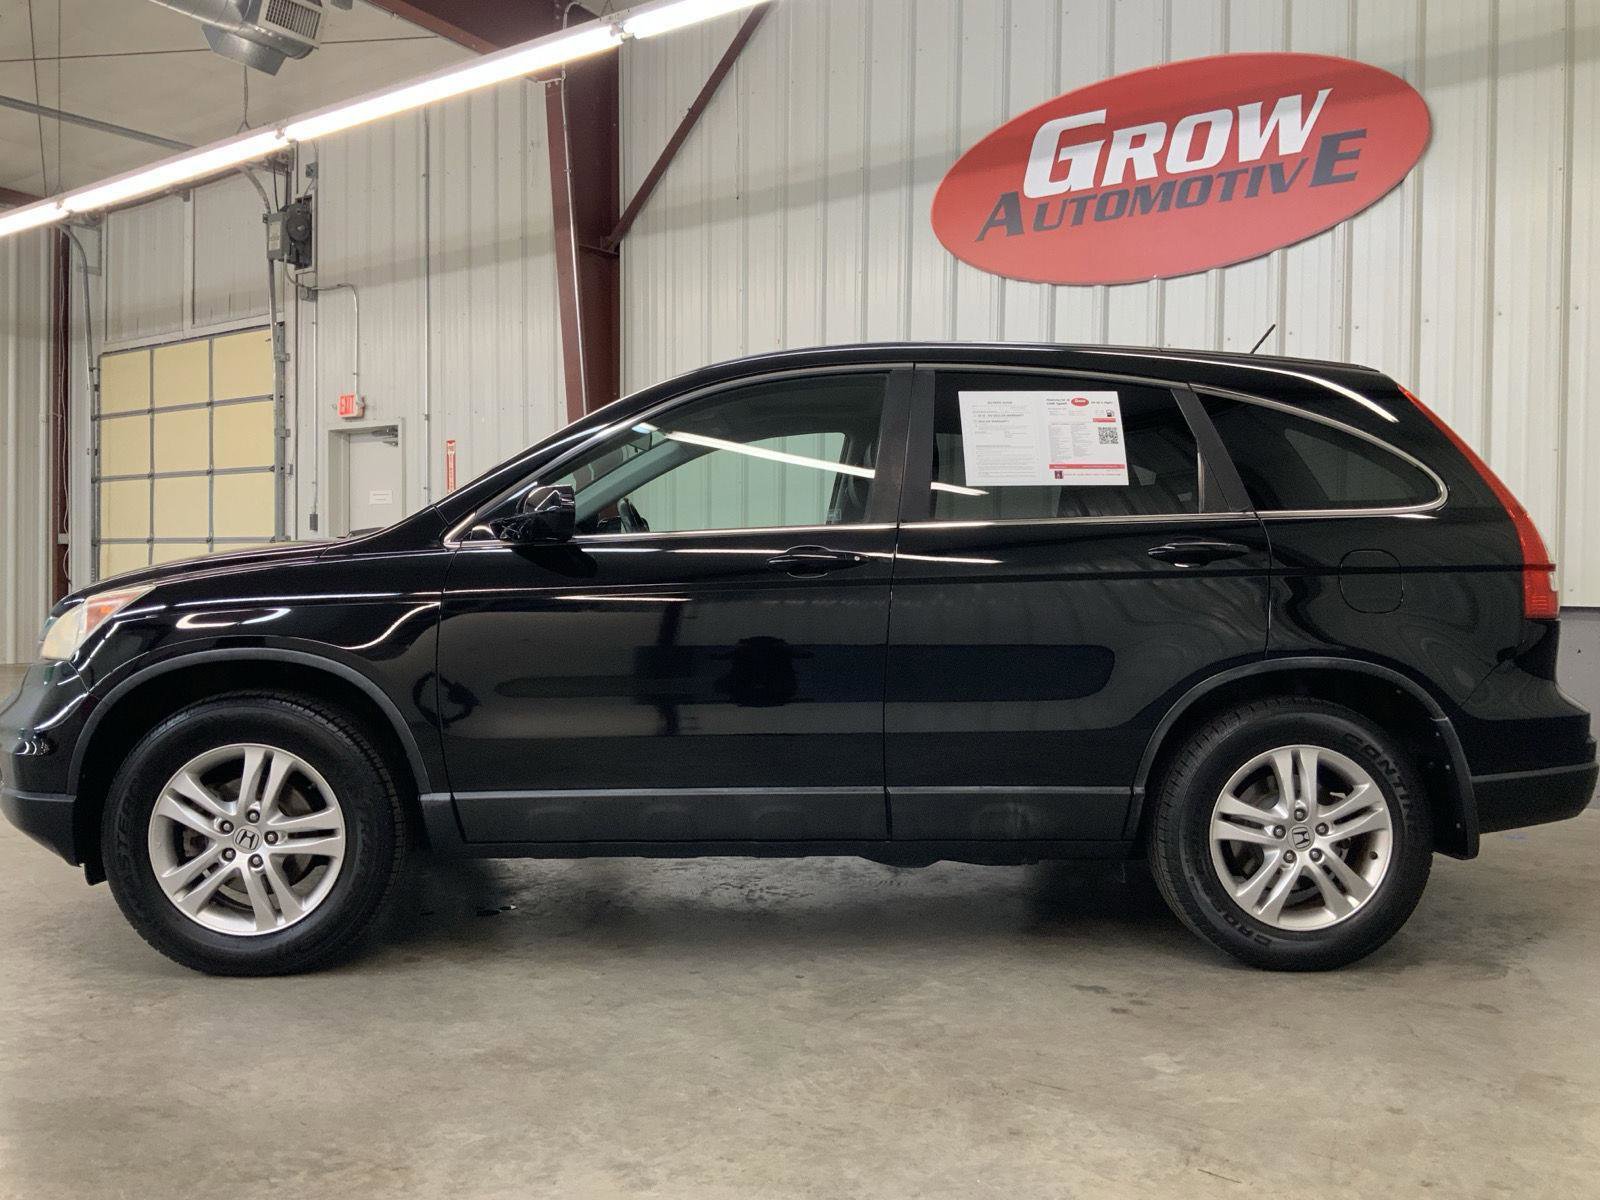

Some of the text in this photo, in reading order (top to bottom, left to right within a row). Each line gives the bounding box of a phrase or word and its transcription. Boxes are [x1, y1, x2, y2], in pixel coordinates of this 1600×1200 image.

[974, 129, 1367, 242] AUTOMOTIVE
[1022, 88, 1333, 199] GROW
[340, 394, 355, 415] EXIT
